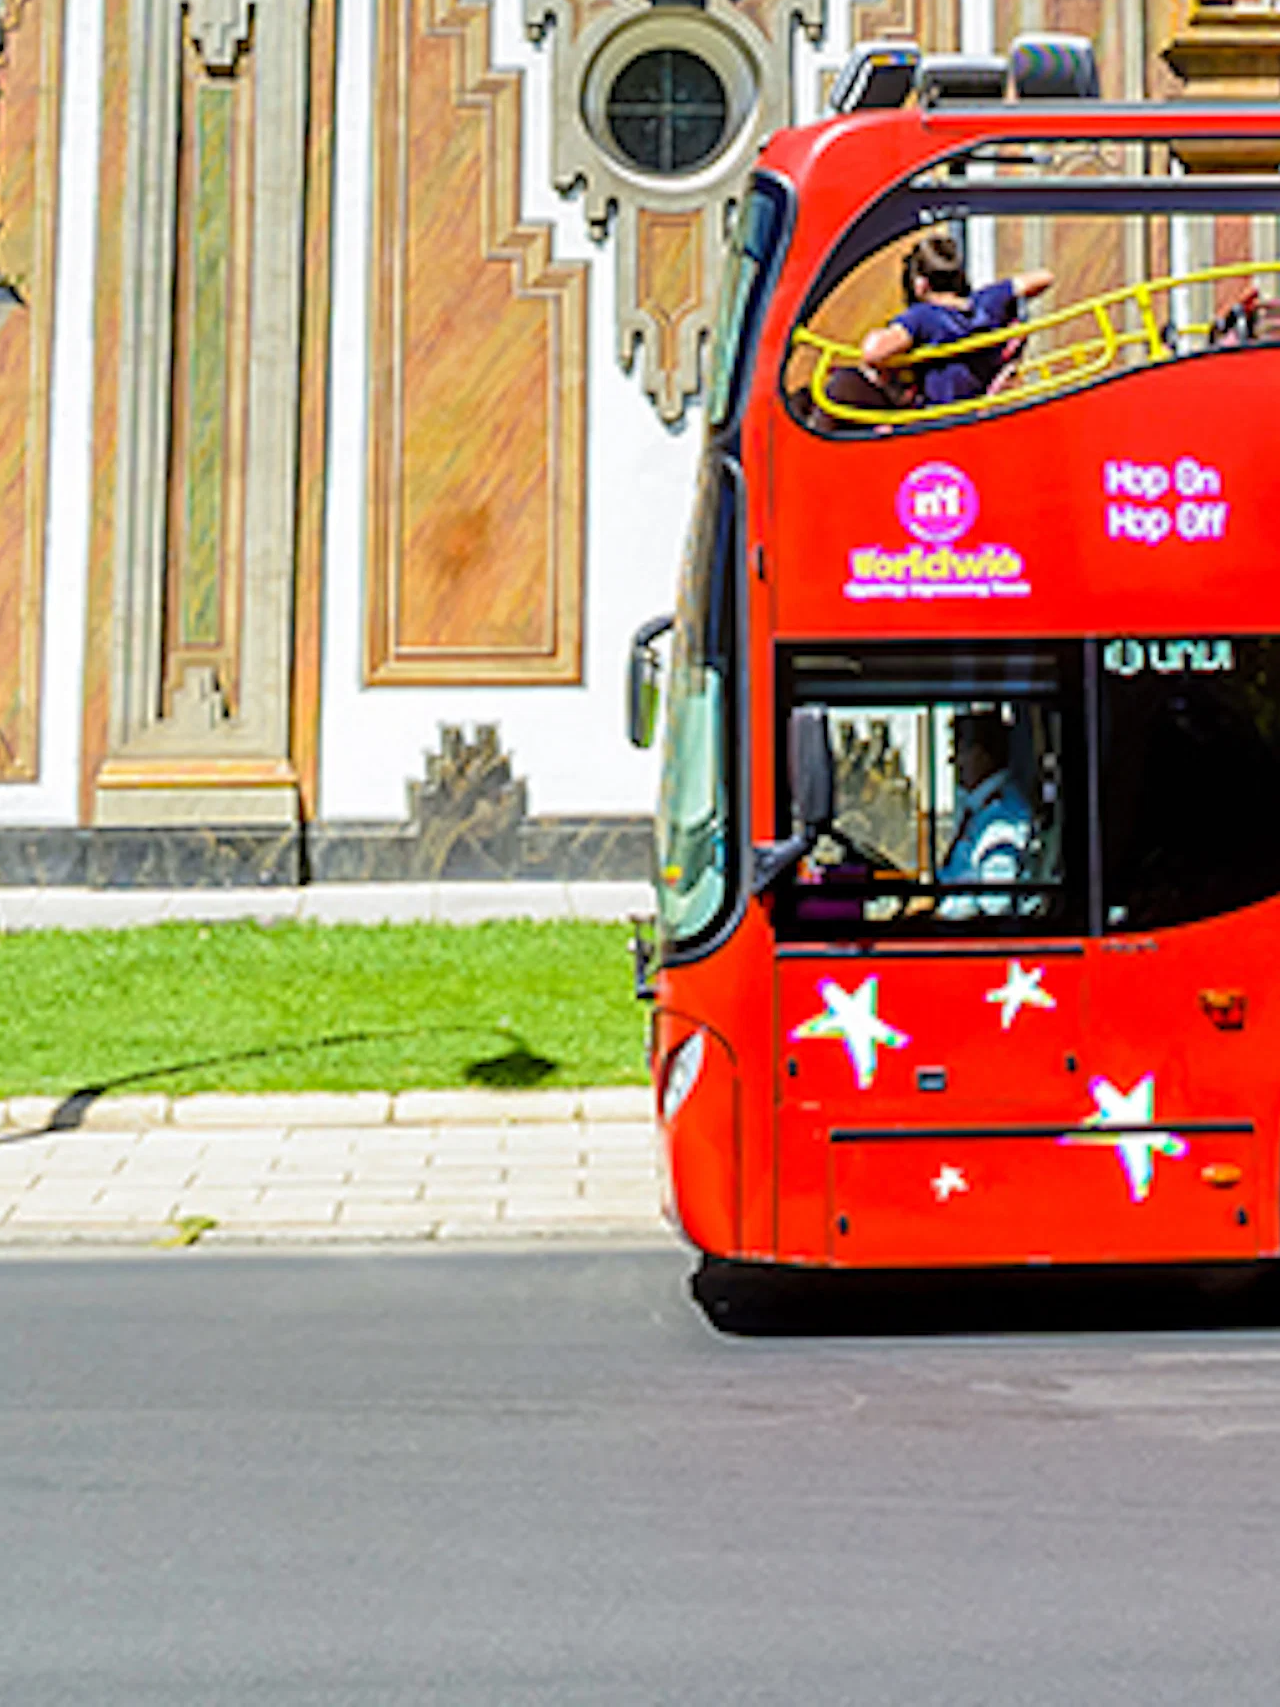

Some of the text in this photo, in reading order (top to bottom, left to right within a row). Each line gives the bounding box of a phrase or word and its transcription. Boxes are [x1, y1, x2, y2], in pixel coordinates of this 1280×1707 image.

[1103, 455, 1221, 504] Hop On
[1105, 499, 1229, 547] Hop Off
